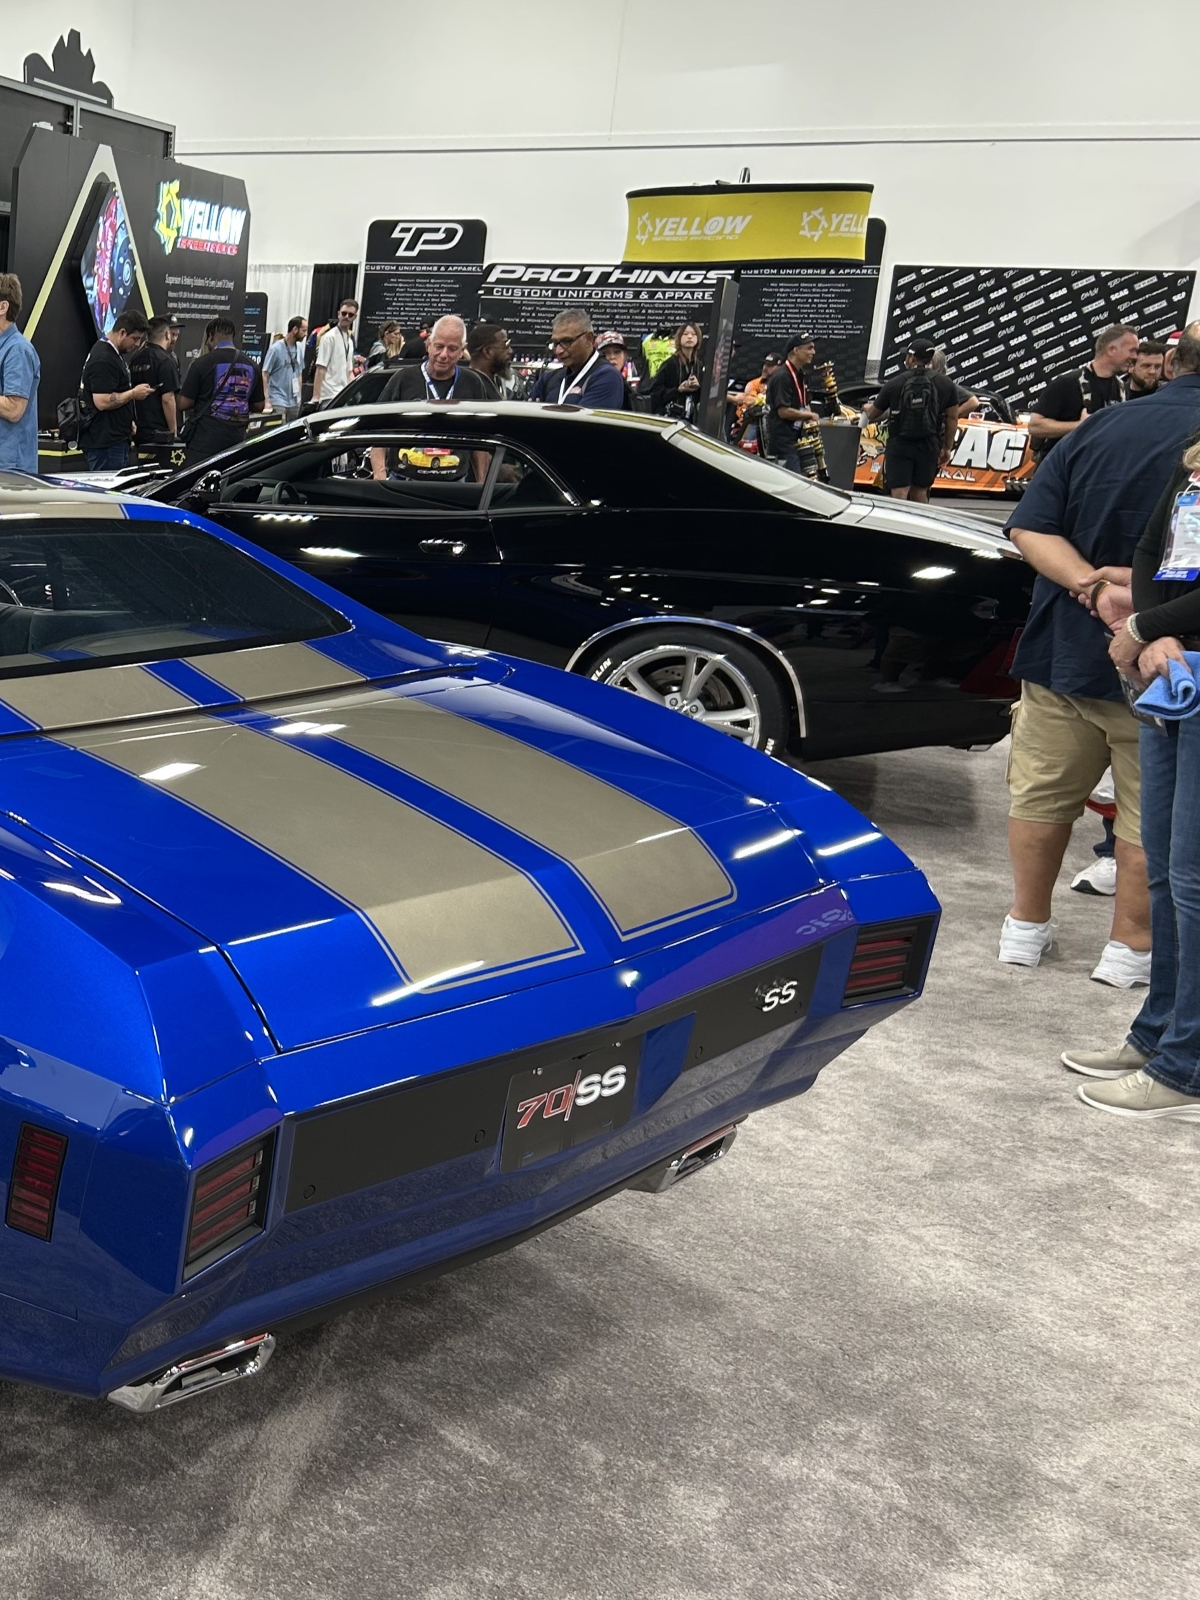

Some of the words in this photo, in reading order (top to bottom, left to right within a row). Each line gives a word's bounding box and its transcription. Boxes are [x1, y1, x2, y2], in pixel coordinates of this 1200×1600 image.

[180, 198, 246, 245] YELLOW
[654, 215, 752, 236] YELLOW
[486, 264, 734, 285] PROTHINGS
[493, 288, 551, 297] CUSTOM
[558, 290, 633, 299] UNIFORMS
[762, 980, 798, 1012] SS
